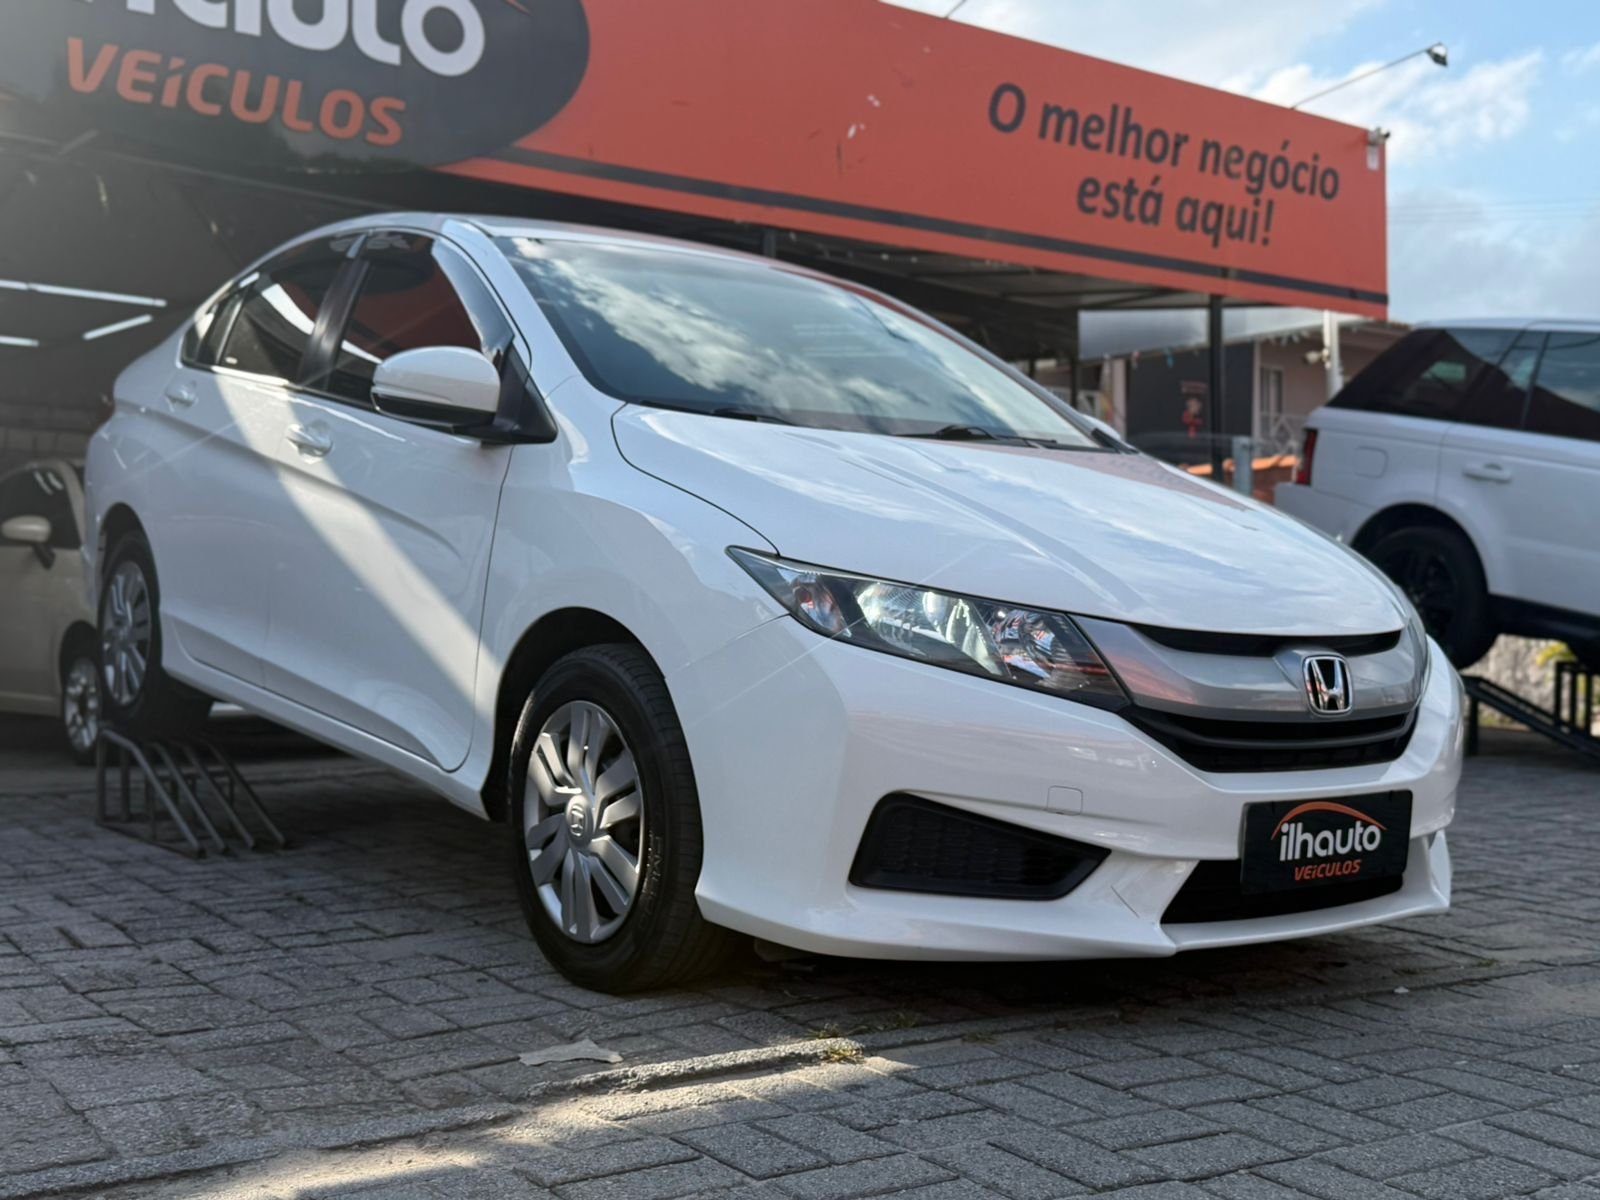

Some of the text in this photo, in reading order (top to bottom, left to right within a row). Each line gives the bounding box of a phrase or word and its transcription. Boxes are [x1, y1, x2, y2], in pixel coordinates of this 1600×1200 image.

[988, 83, 1340, 200] O melhor negócio
[1076, 175, 1275, 249] está aqui!
[1279, 820, 1381, 861] ilhauto
